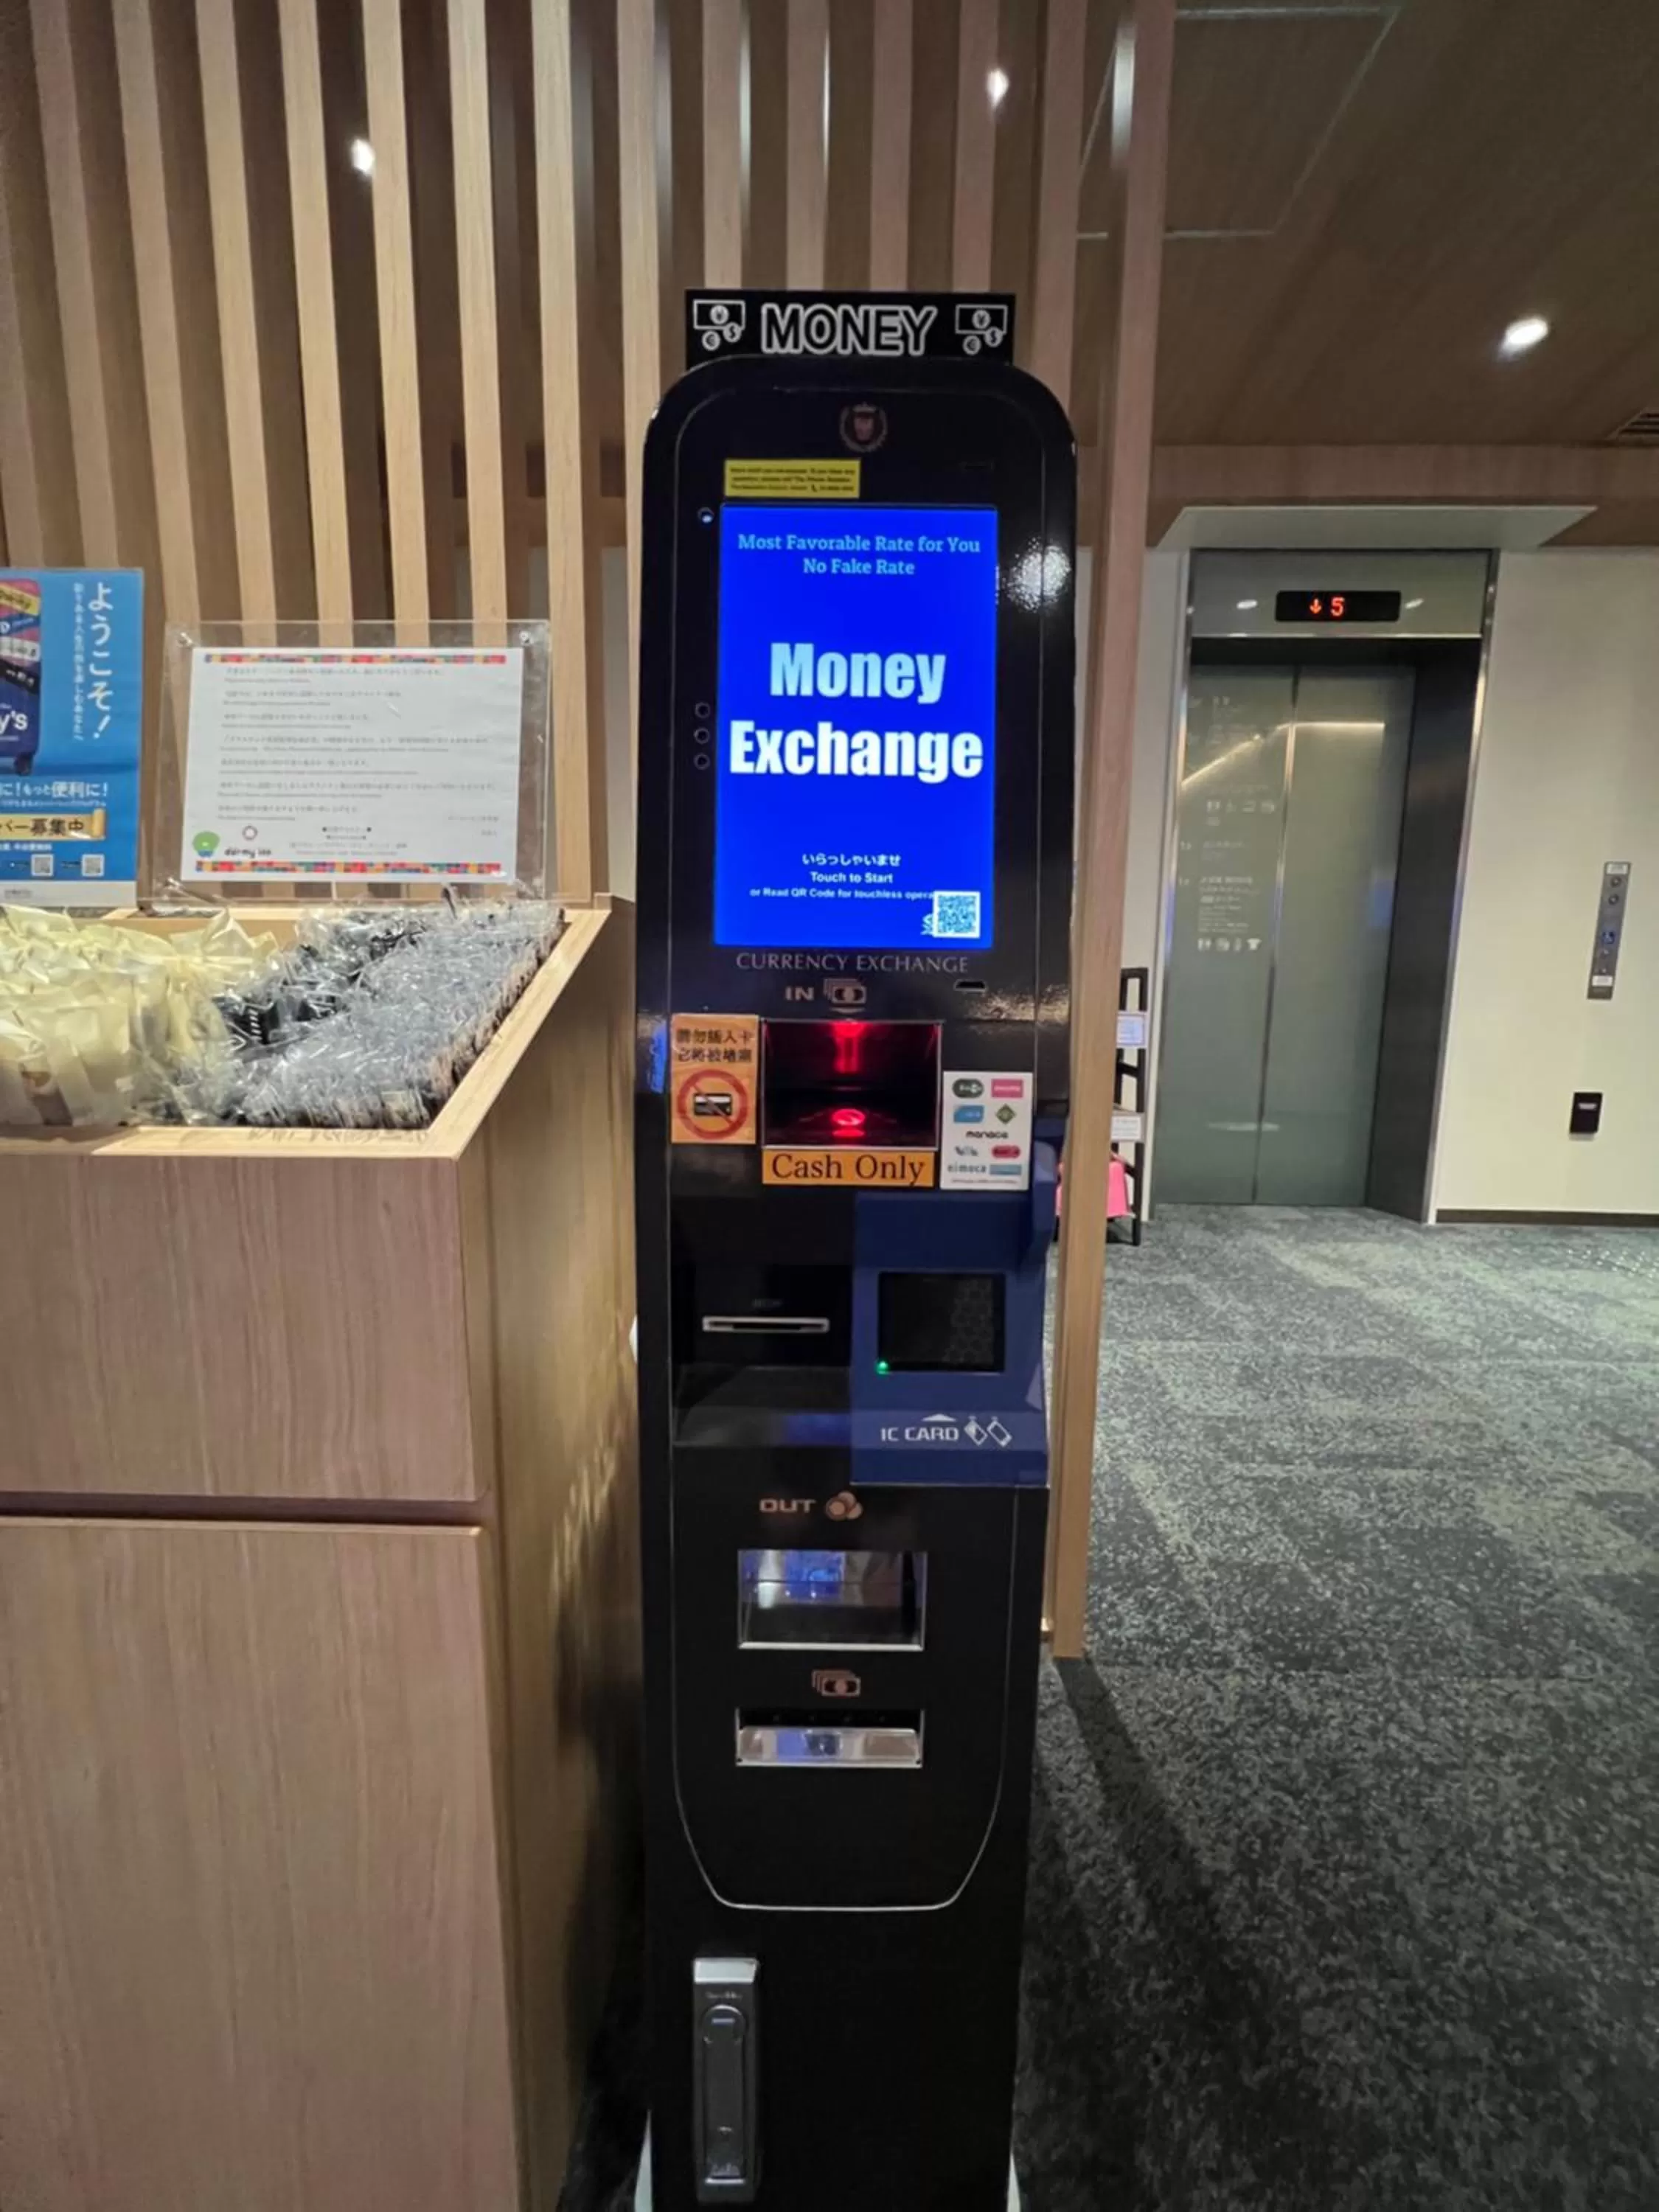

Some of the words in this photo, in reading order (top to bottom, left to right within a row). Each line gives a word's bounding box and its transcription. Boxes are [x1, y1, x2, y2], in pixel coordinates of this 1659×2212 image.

[761, 303, 938, 355] MONEY
[738, 534, 782, 550] Most
[786, 535, 870, 551] Favorable
[875, 536, 914, 552] Rate
[919, 536, 944, 552] for
[947, 537, 980, 553] You
[803, 557, 827, 574] No
[831, 558, 872, 574] Fake
[876, 559, 915, 575] Rate
[1331, 597, 1345, 616] 5
[770, 642, 946, 704] Money
[729, 720, 984, 784] Exchange
[802, 853, 901, 867] いらっしゃいませ
[810, 872, 846, 883] Touch
[849, 872, 862, 883] to
[864, 872, 894, 883] Start
[750, 888, 761, 897] or
[763, 887, 789, 897] Read
[790, 888, 807, 897] QR
[809, 888, 835, 898] Code
[838, 888, 852, 898] for
[854, 888, 902, 899] touchless
[736, 952, 848, 970] CURRENCY
[855, 955, 969, 973] EXCHANGE
[785, 986, 814, 1001] IN
[772, 1153, 843, 1178] Cash
[855, 1154, 925, 1187] Only
[880, 1427, 899, 1441] IC
[905, 1427, 959, 1441] CARD
[759, 1498, 816, 1513] OUT
